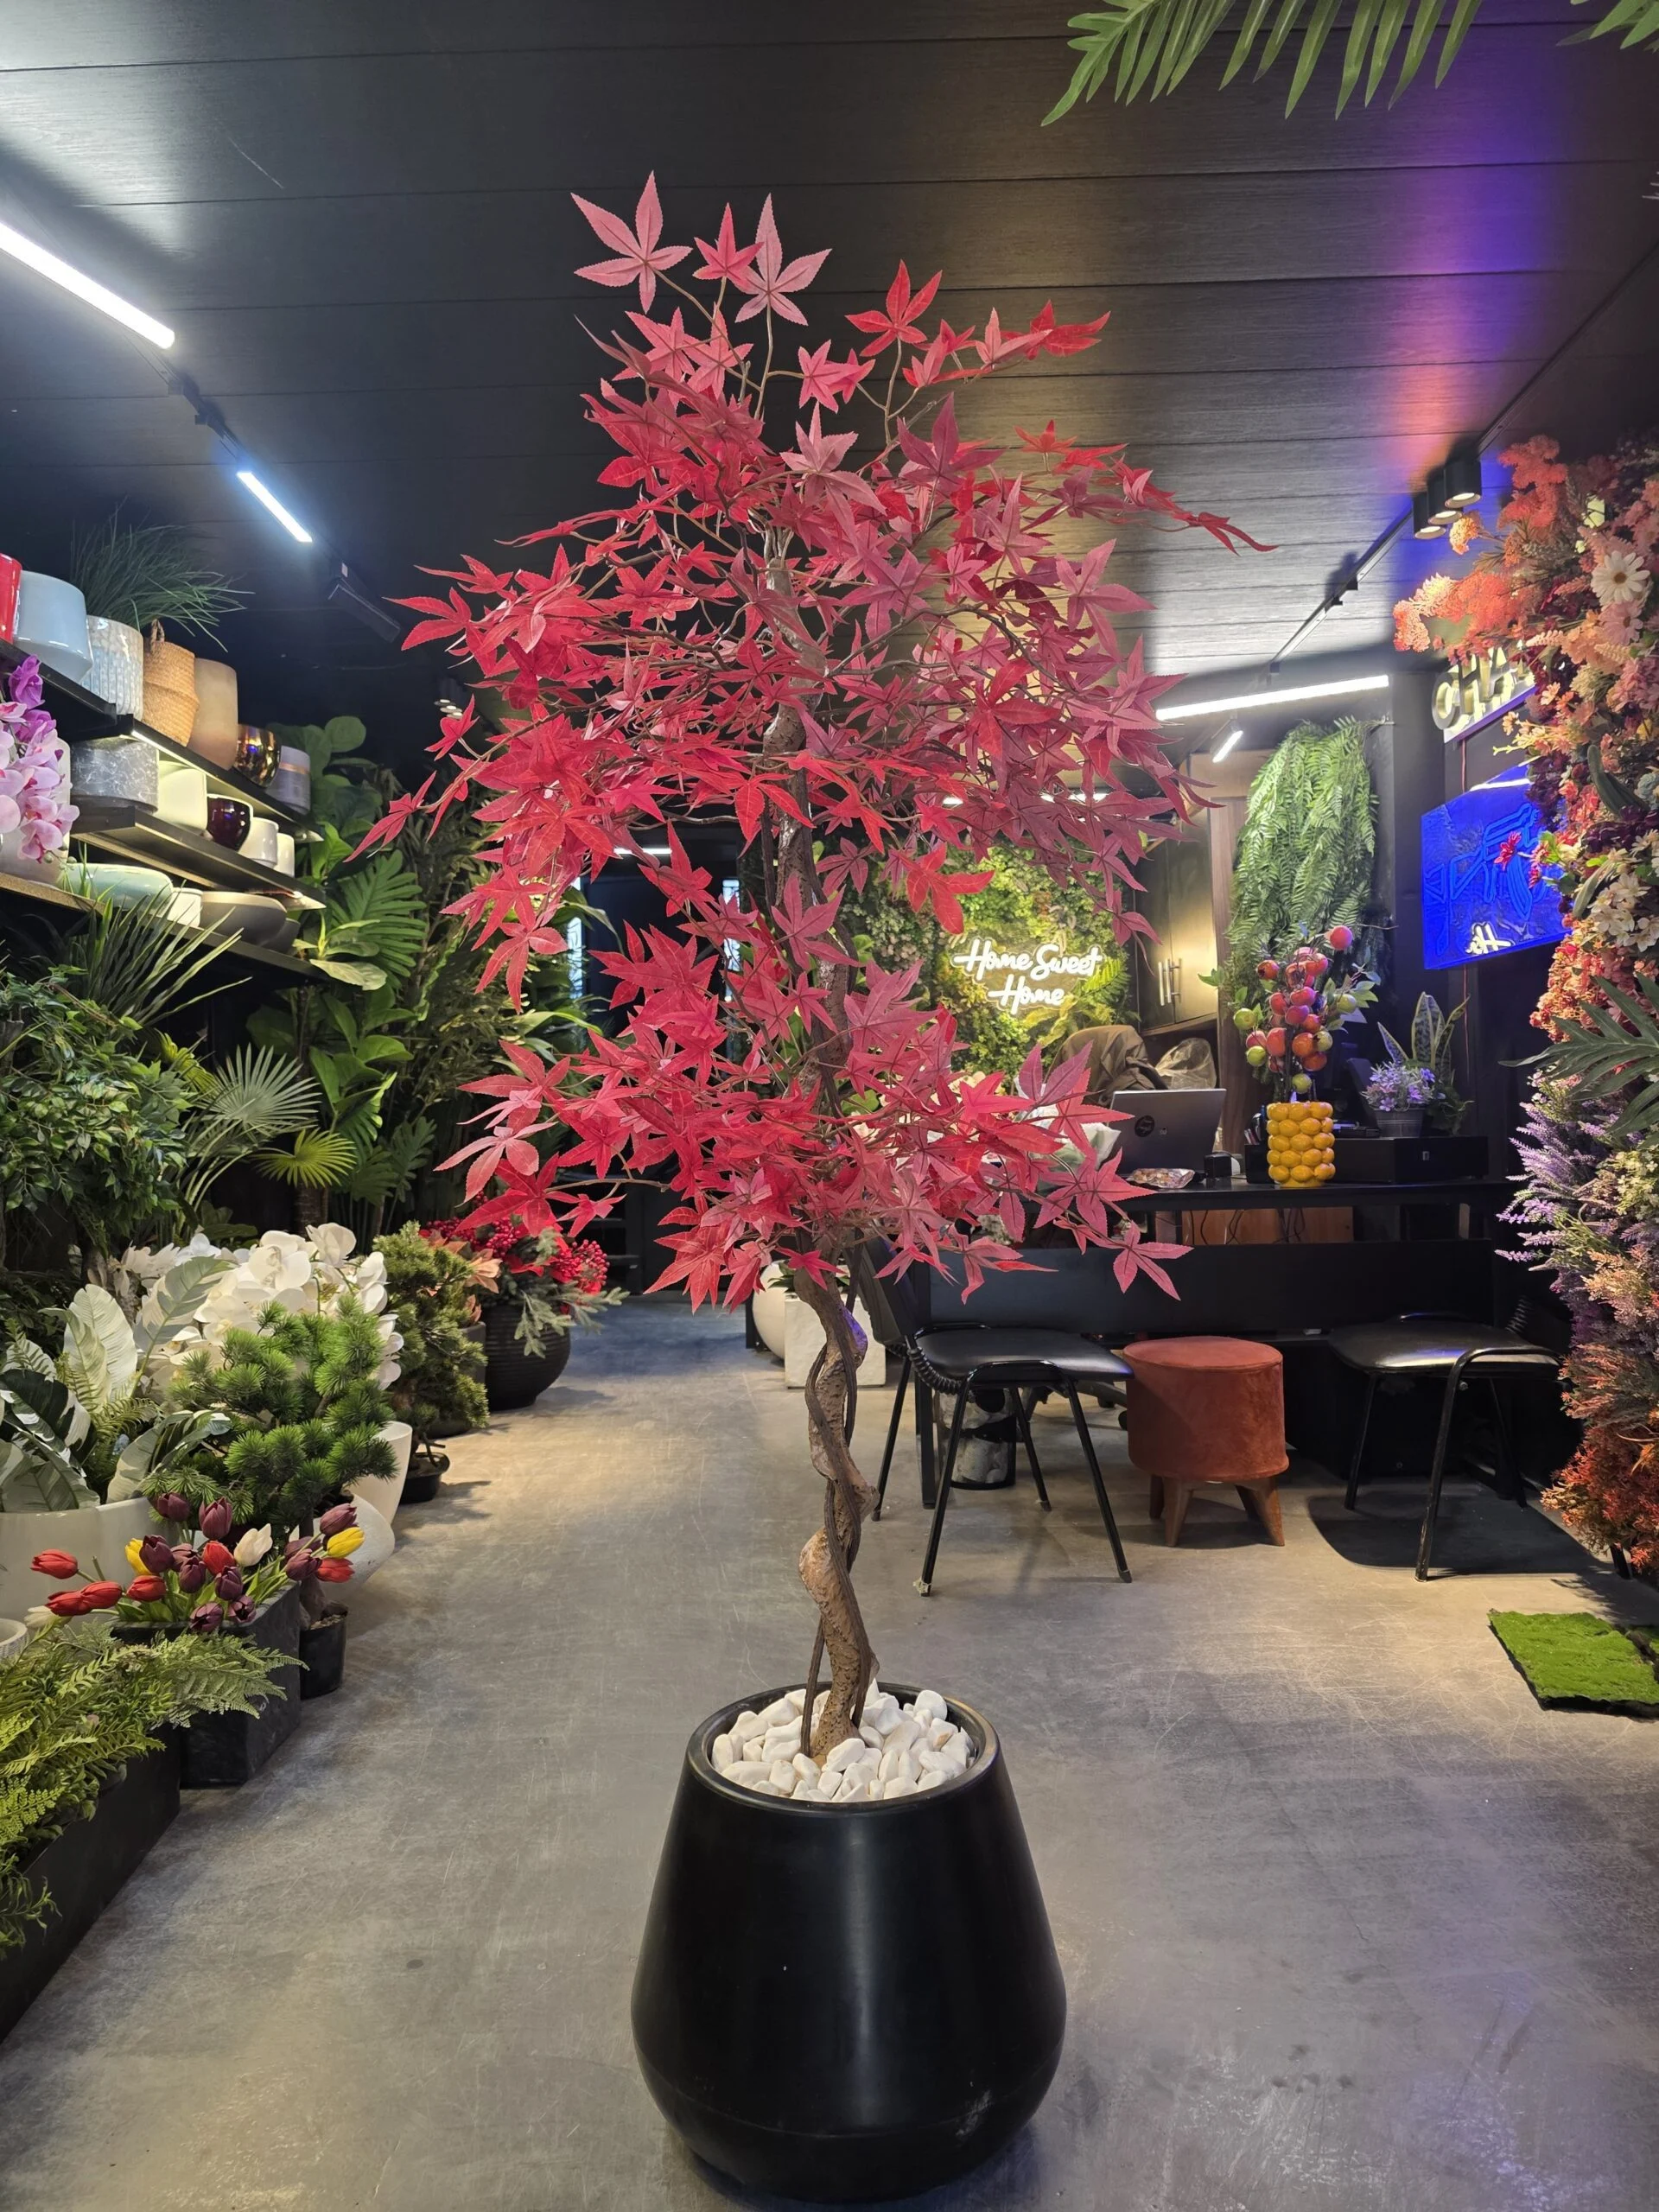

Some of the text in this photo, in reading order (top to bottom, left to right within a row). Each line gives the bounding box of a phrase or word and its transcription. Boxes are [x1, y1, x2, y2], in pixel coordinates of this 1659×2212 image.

[953, 938, 1103, 982] Home Sweet
[988, 973, 1065, 1015] Home
